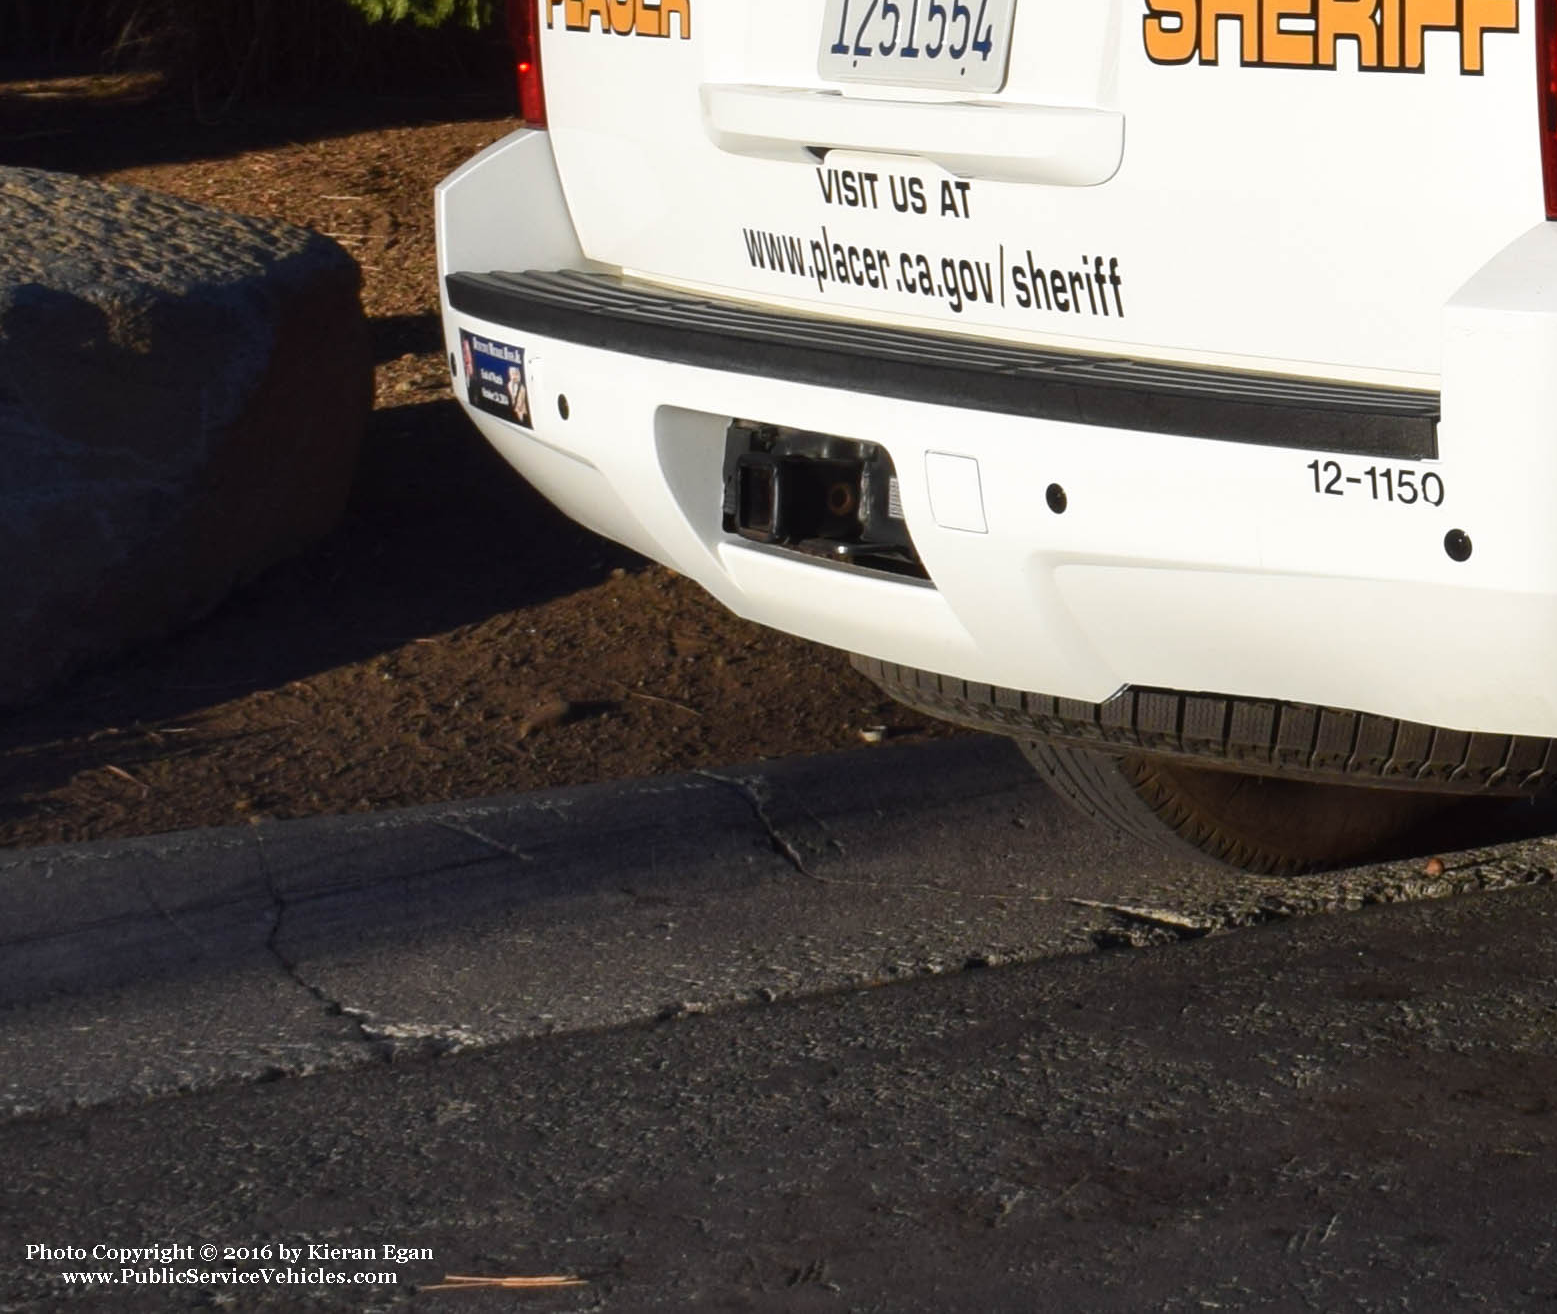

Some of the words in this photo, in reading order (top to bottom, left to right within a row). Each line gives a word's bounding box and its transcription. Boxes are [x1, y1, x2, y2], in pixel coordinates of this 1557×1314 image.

[816, 167, 878, 210] VISIT
[888, 174, 928, 215] US
[940, 179, 971, 219] AT
[1307, 459, 1445, 507] 12-1150
